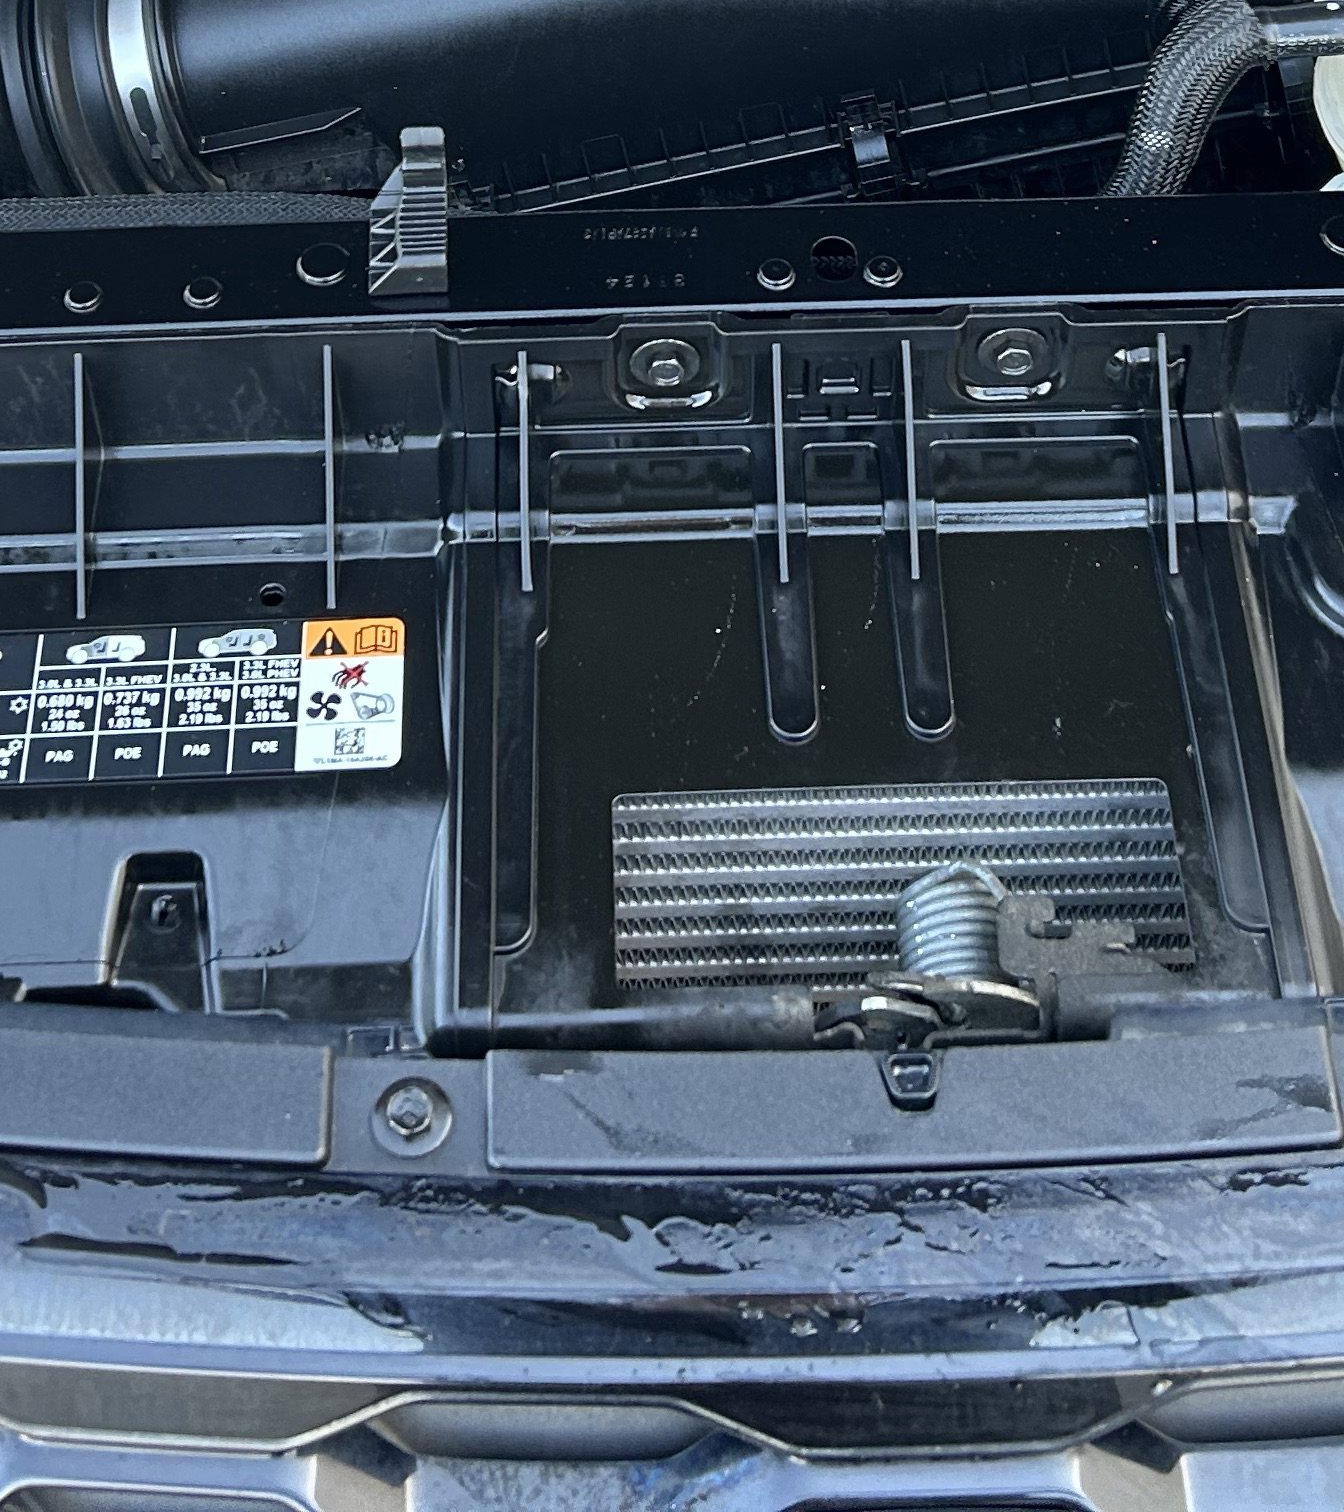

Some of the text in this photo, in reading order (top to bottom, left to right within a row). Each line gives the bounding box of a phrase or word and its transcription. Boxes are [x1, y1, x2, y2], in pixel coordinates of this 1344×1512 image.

[267, 658, 299, 669] FHEV
[130, 674, 163, 684] FHEV
[103, 690, 160, 706] 0.737 kg
[174, 687, 231, 702] 0.992 kg
[240, 684, 297, 700] 0.992 kg
[37, 693, 94, 709] 0.680 kg
[187, 701, 218, 713] 35 oz
[253, 698, 284, 711] 35 oz
[48, 708, 81, 720] 24 oz
[131, 706, 147, 716] oz
[270, 710, 290, 722] lbs
[132, 717, 152, 728] lbs
[204, 713, 224, 724] lbs
[66, 720, 86, 731] lbs
[182, 743, 211, 757] PAG
[251, 740, 279, 753] POE
[45, 749, 74, 763] PAG
[114, 746, 142, 760] POE
